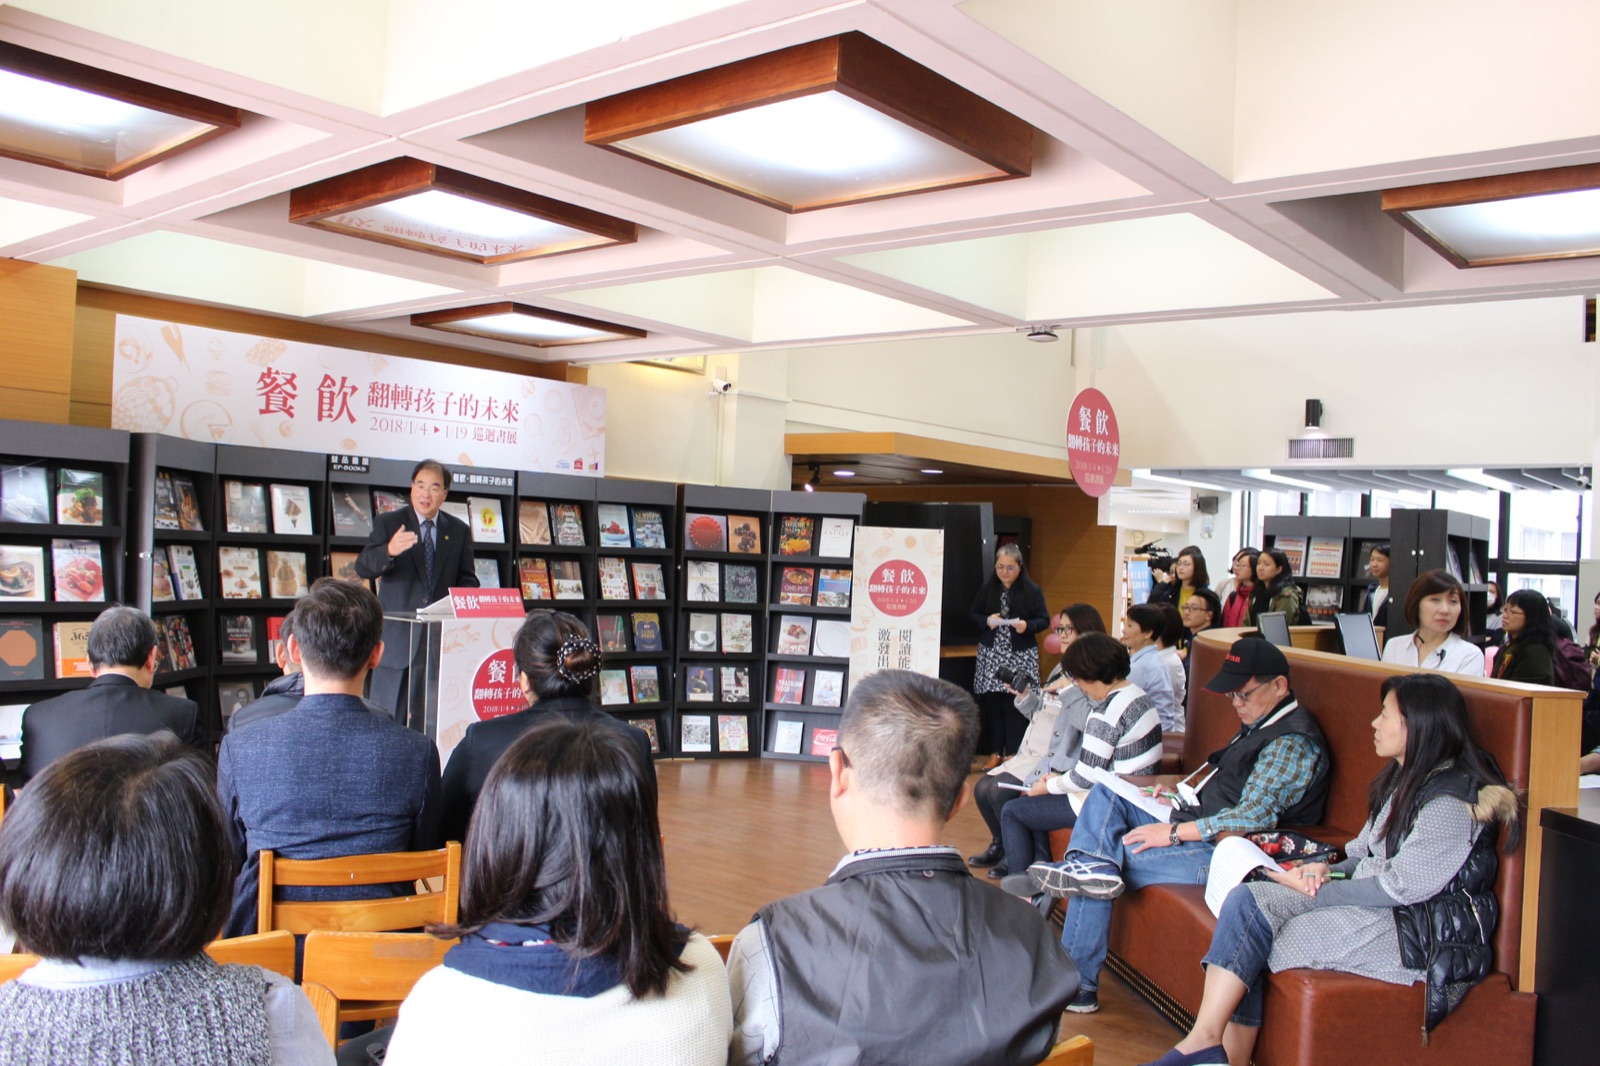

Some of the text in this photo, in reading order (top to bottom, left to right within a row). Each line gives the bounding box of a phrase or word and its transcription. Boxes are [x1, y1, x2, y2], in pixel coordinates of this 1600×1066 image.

[256, 366, 359, 424] 餐飲
[367, 381, 520, 424] 翻轉孩子的未來
[370, 416, 518, 445] 2018/1/4 1/19 巡迴書展
[1079, 405, 1109, 436] 餐飲
[1067, 433, 1120, 457] 翻轉孩子的未來
[882, 568, 915, 584] 餐飲
[868, 583, 927, 596] 翻轉孩子的未來
[453, 595, 480, 611] 餐飲
